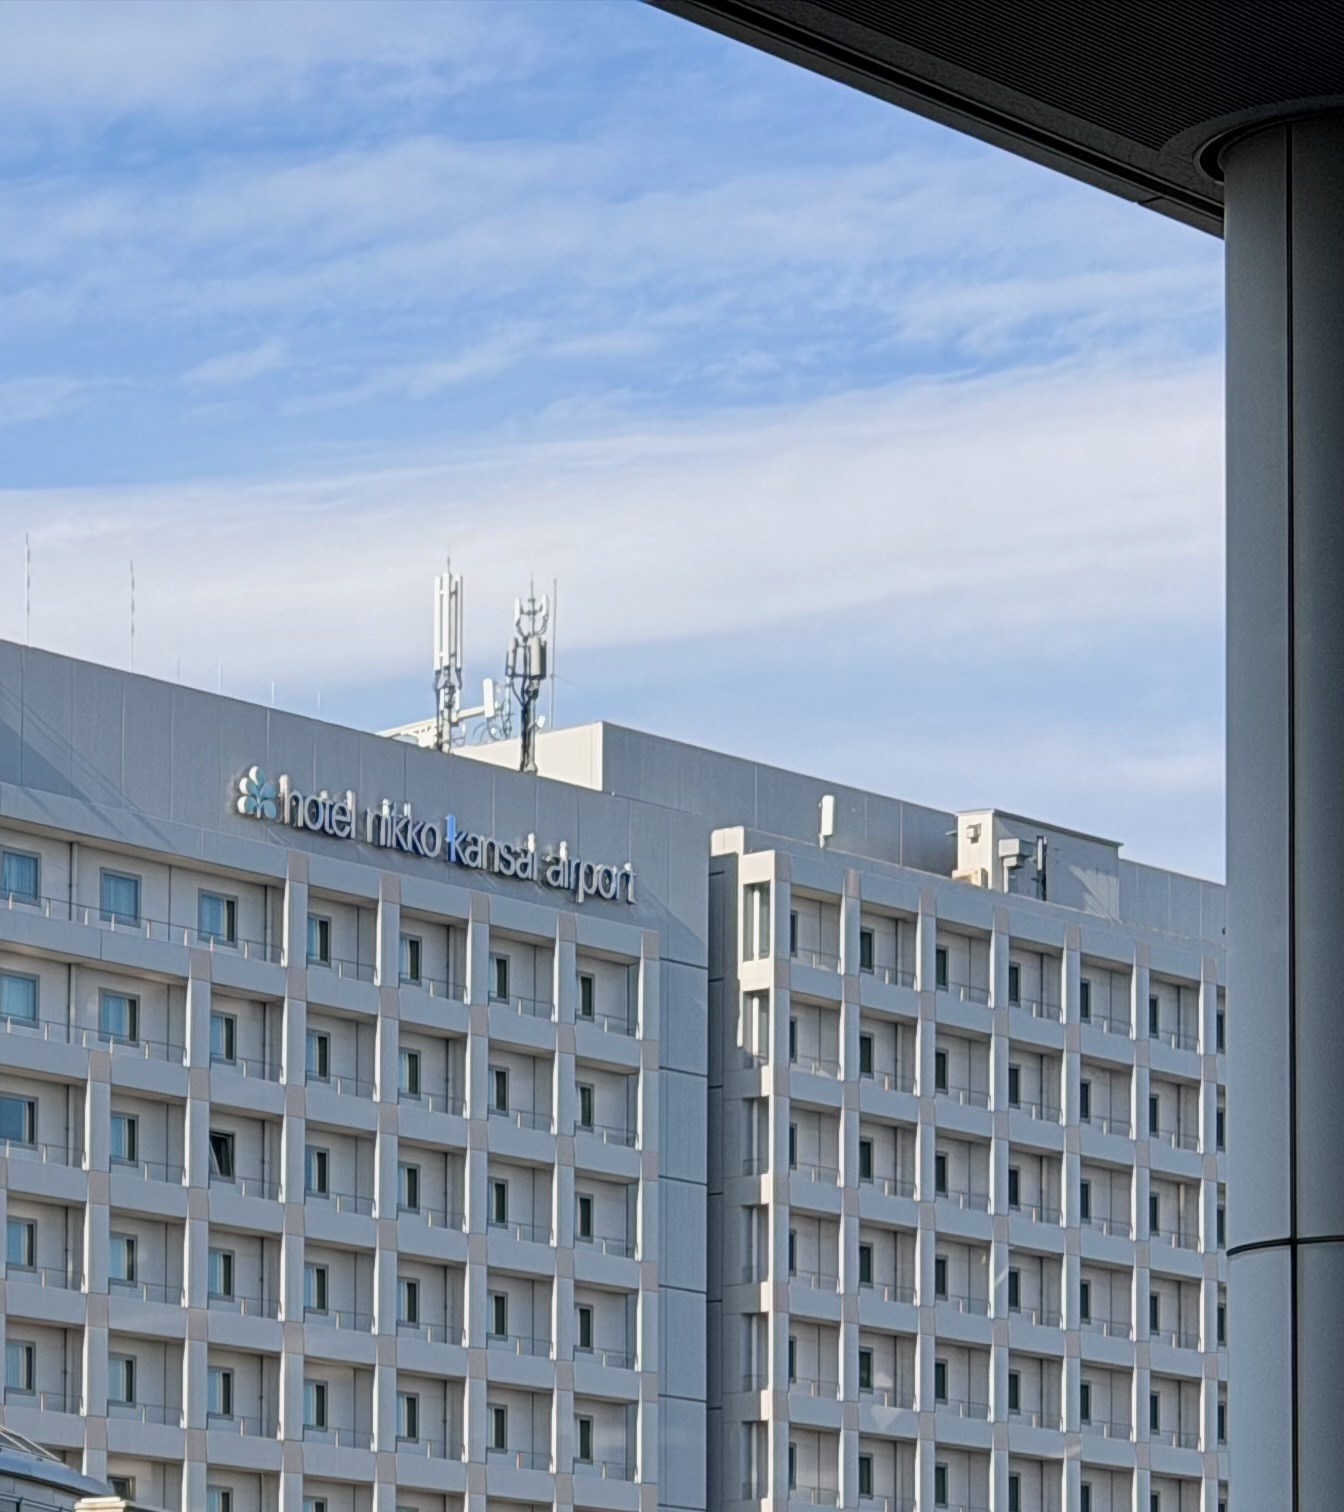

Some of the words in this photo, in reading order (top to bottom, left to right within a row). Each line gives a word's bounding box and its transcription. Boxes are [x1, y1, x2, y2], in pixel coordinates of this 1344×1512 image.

[278, 774, 357, 839] hotel
[364, 798, 442, 858] nikko
[445, 814, 538, 881] kansai
[542, 840, 637, 904] airport
